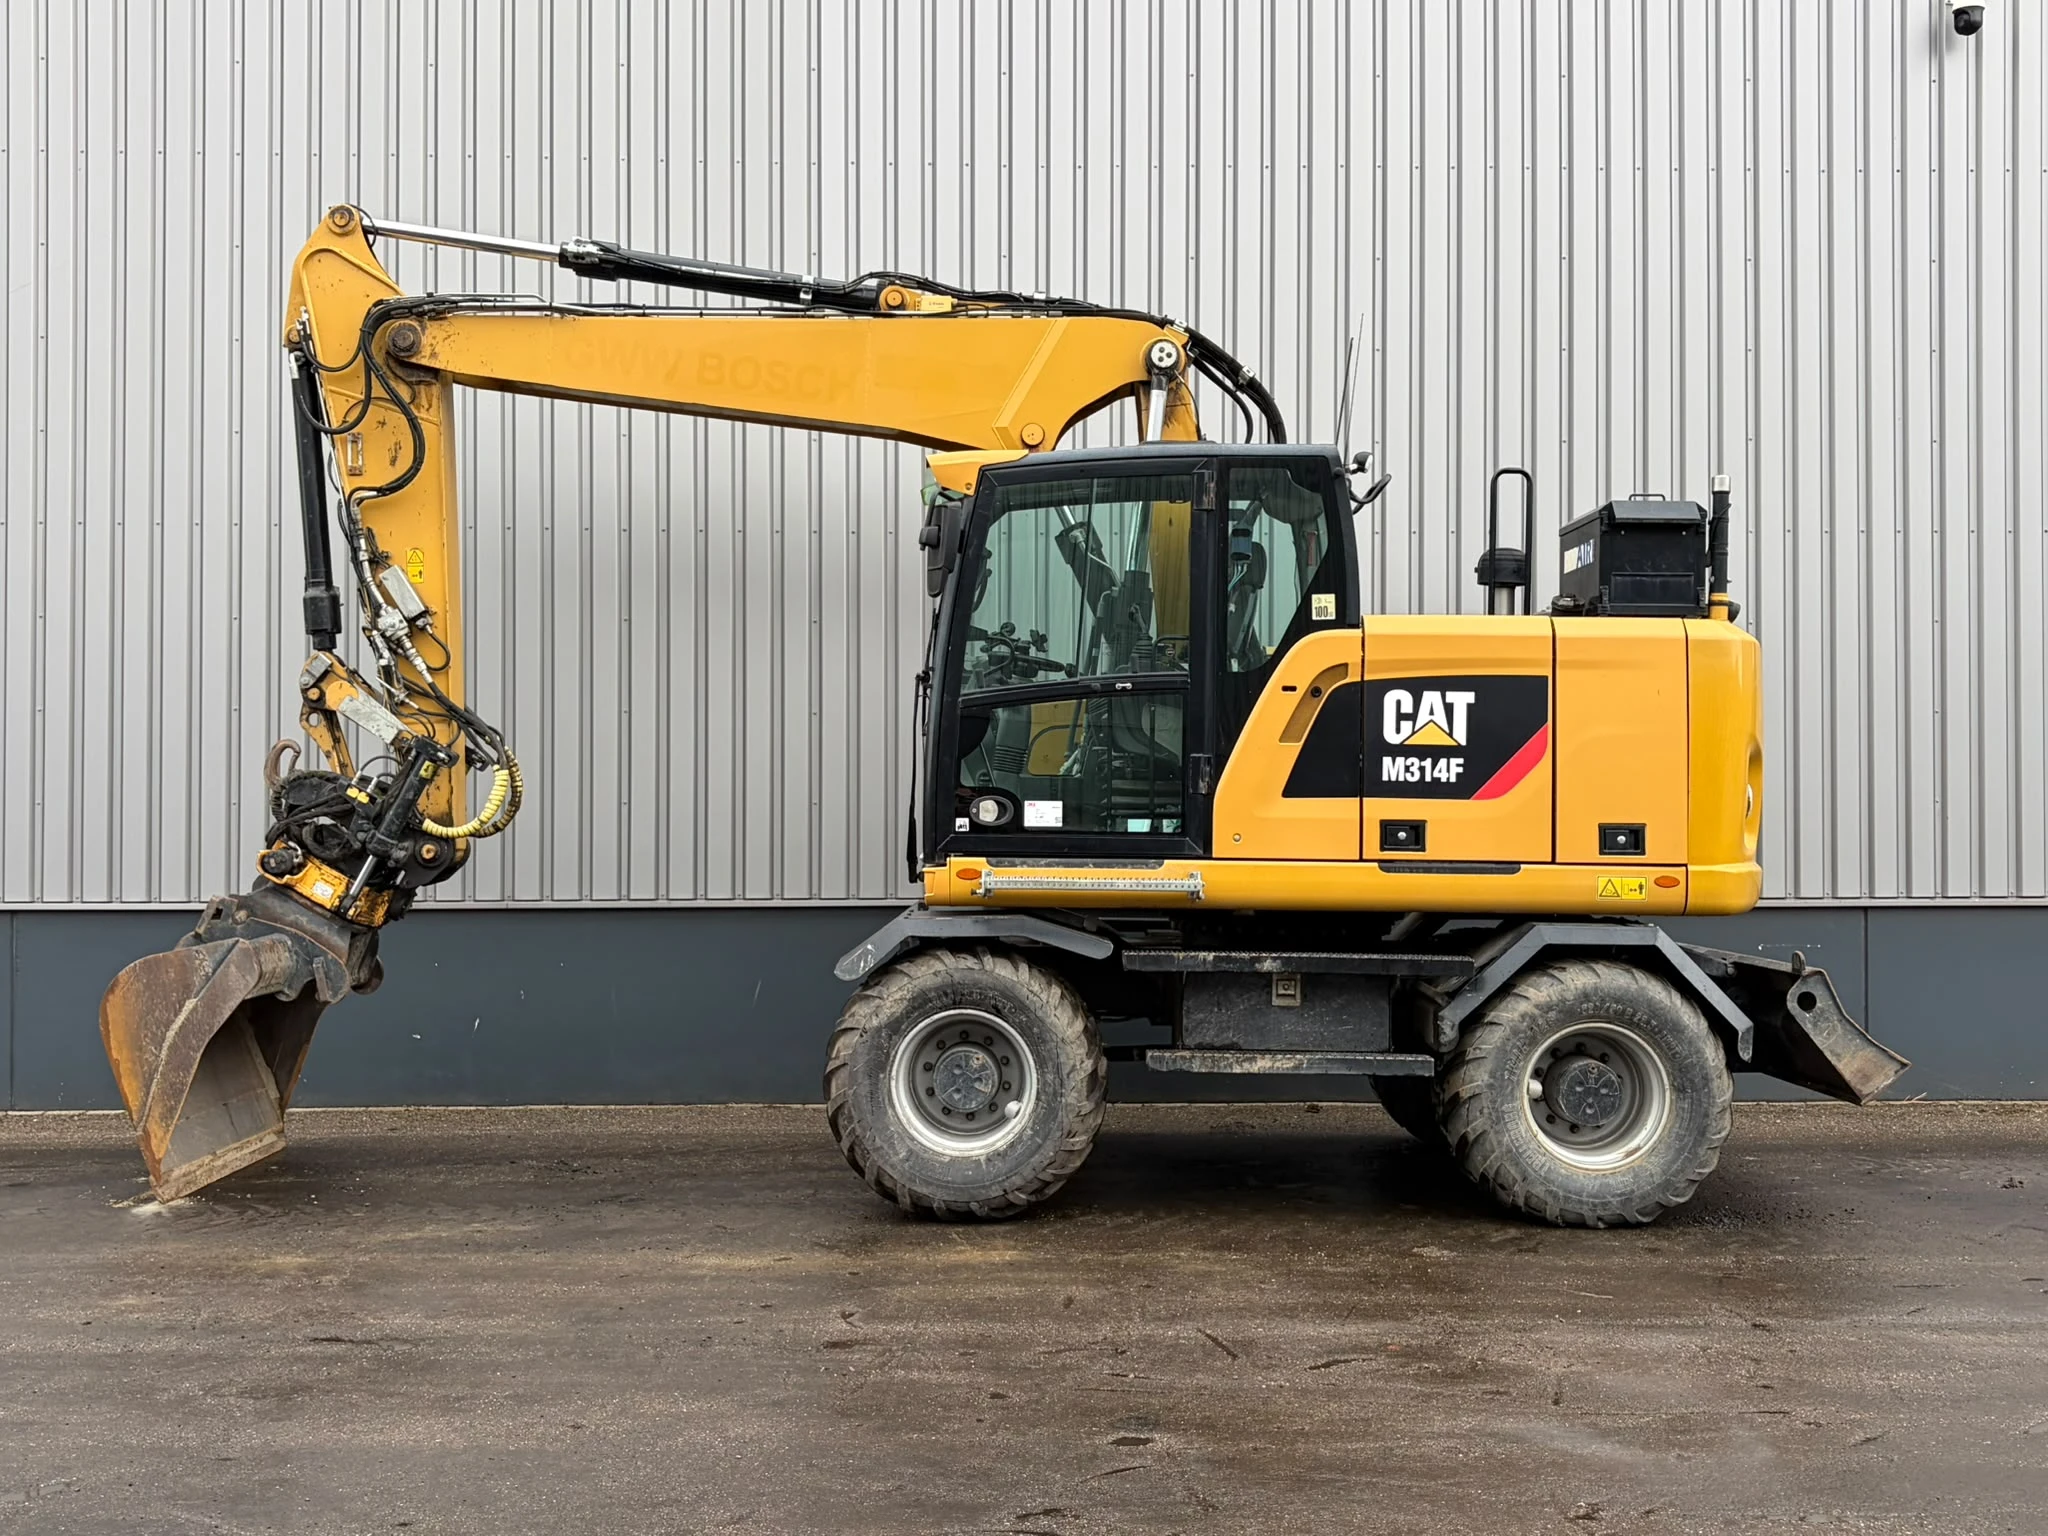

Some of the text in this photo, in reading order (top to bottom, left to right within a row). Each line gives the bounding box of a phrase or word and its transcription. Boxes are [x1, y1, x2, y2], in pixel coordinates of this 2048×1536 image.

[697, 352, 858, 403] BOSCH
[1314, 605, 1328, 618] 100
[1383, 689, 1475, 746] CAT
[1382, 756, 1464, 783] M314F
